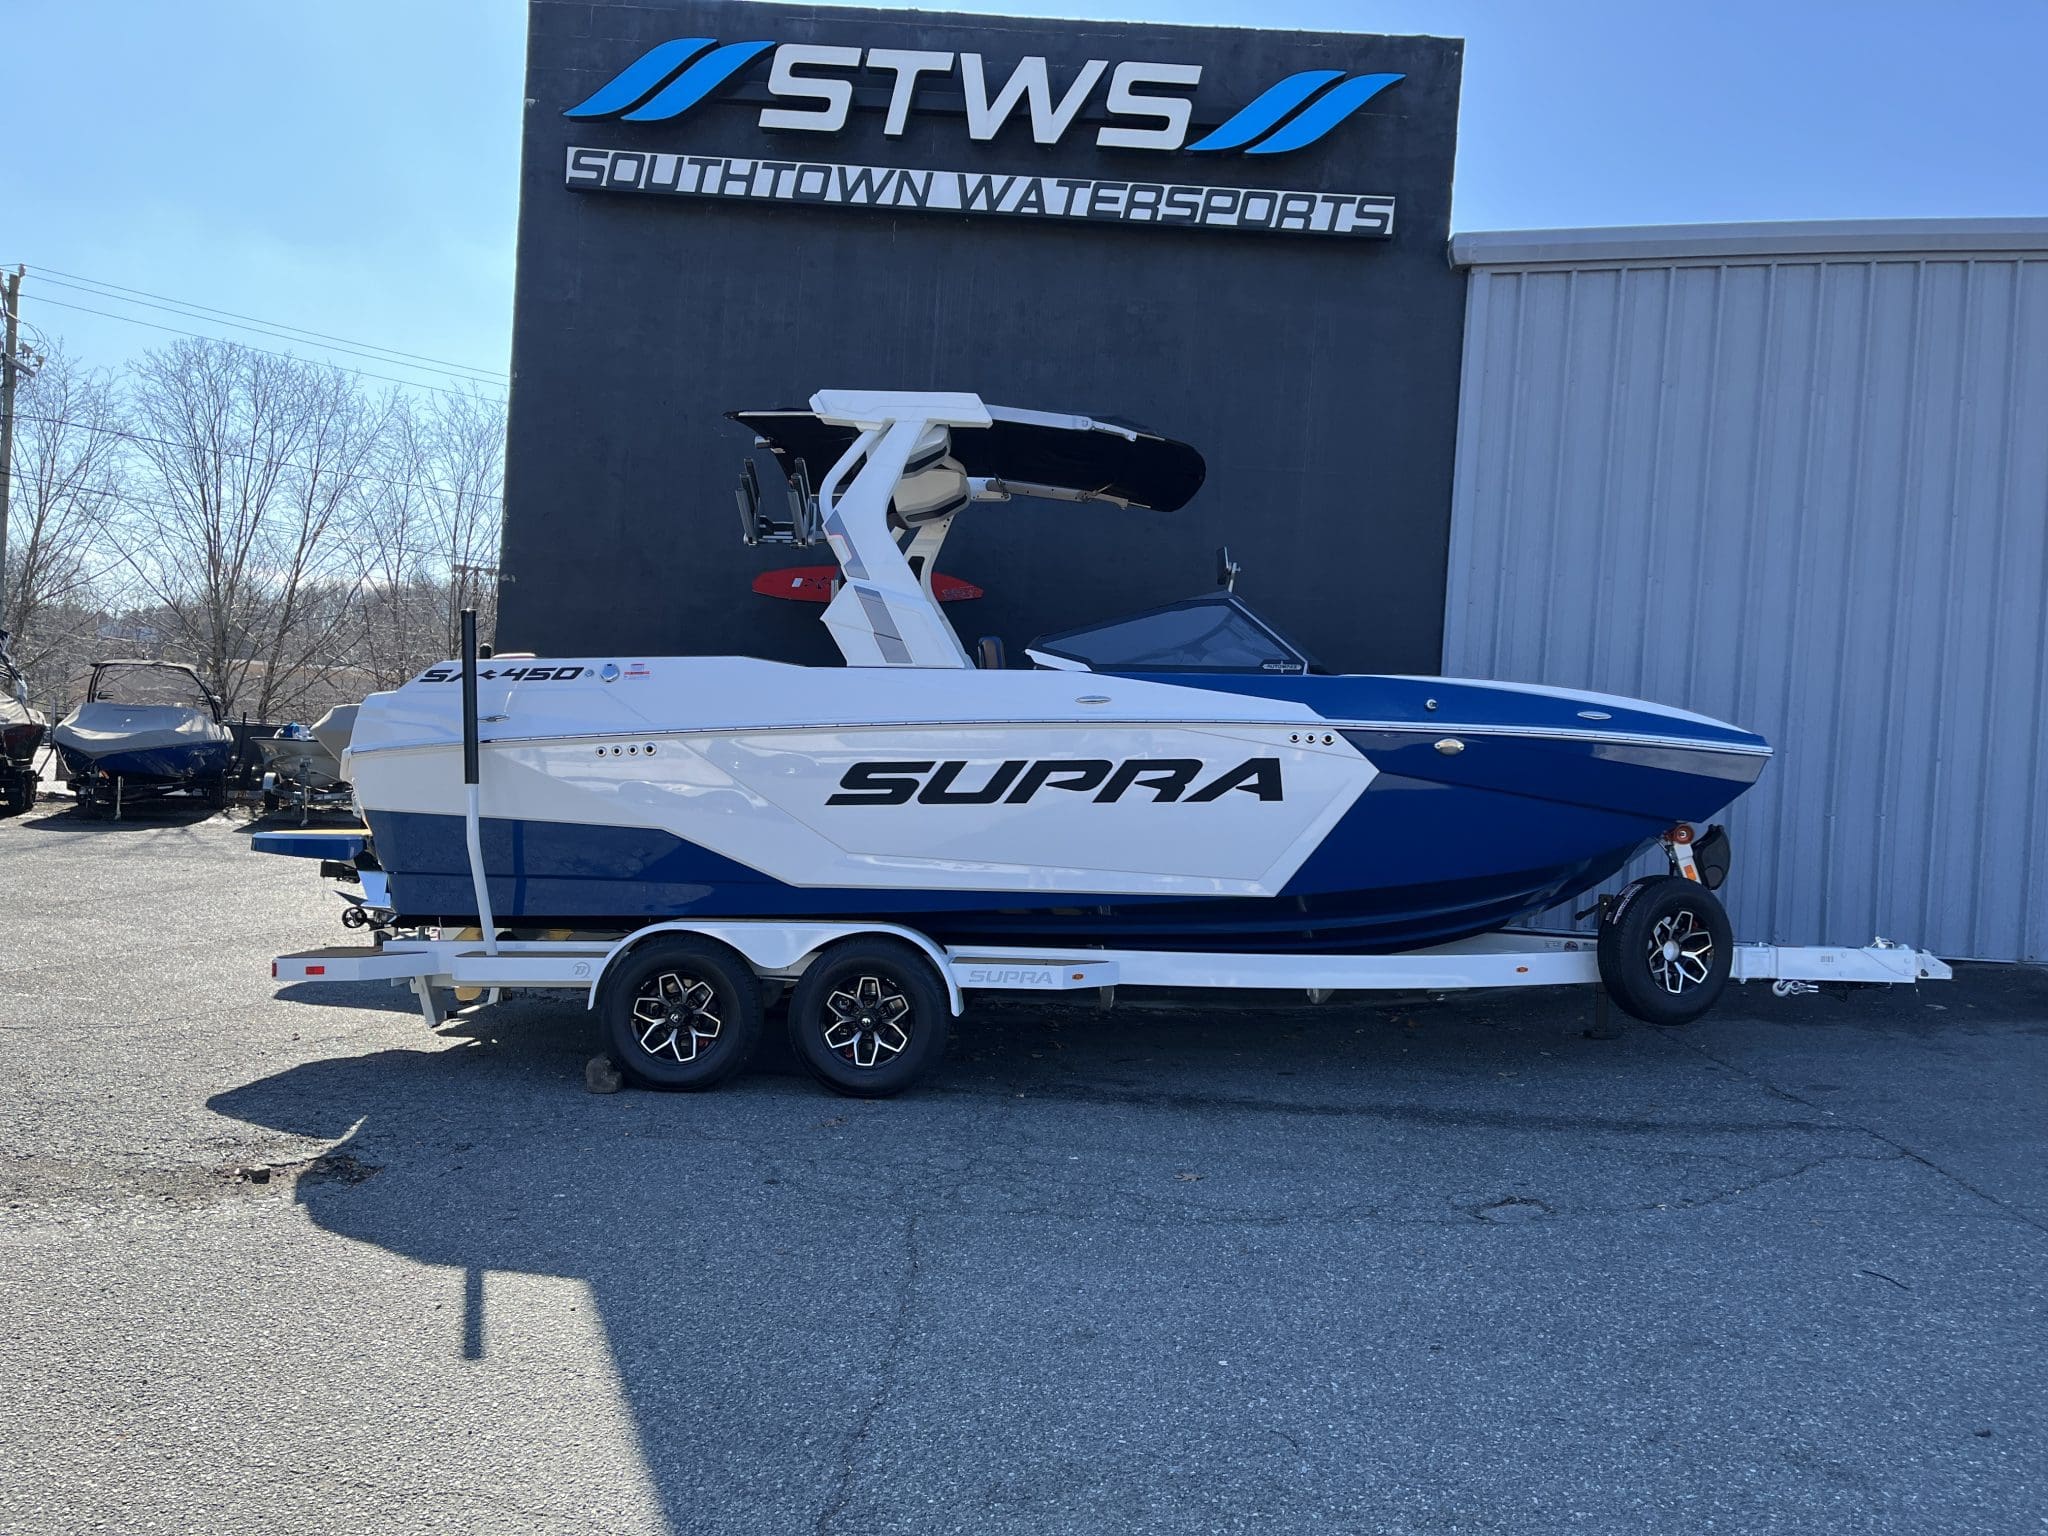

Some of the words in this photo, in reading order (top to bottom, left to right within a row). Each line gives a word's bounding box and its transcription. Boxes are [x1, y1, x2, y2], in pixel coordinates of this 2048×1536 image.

[758, 43, 1203, 151] STWS
[565, 149, 934, 208] SOUTHTOWN
[957, 173, 1394, 235] WATERSPORTS
[499, 666, 585, 682] 450
[824, 758, 1284, 806] SUPRA
[968, 969, 1053, 985] SUPRA
